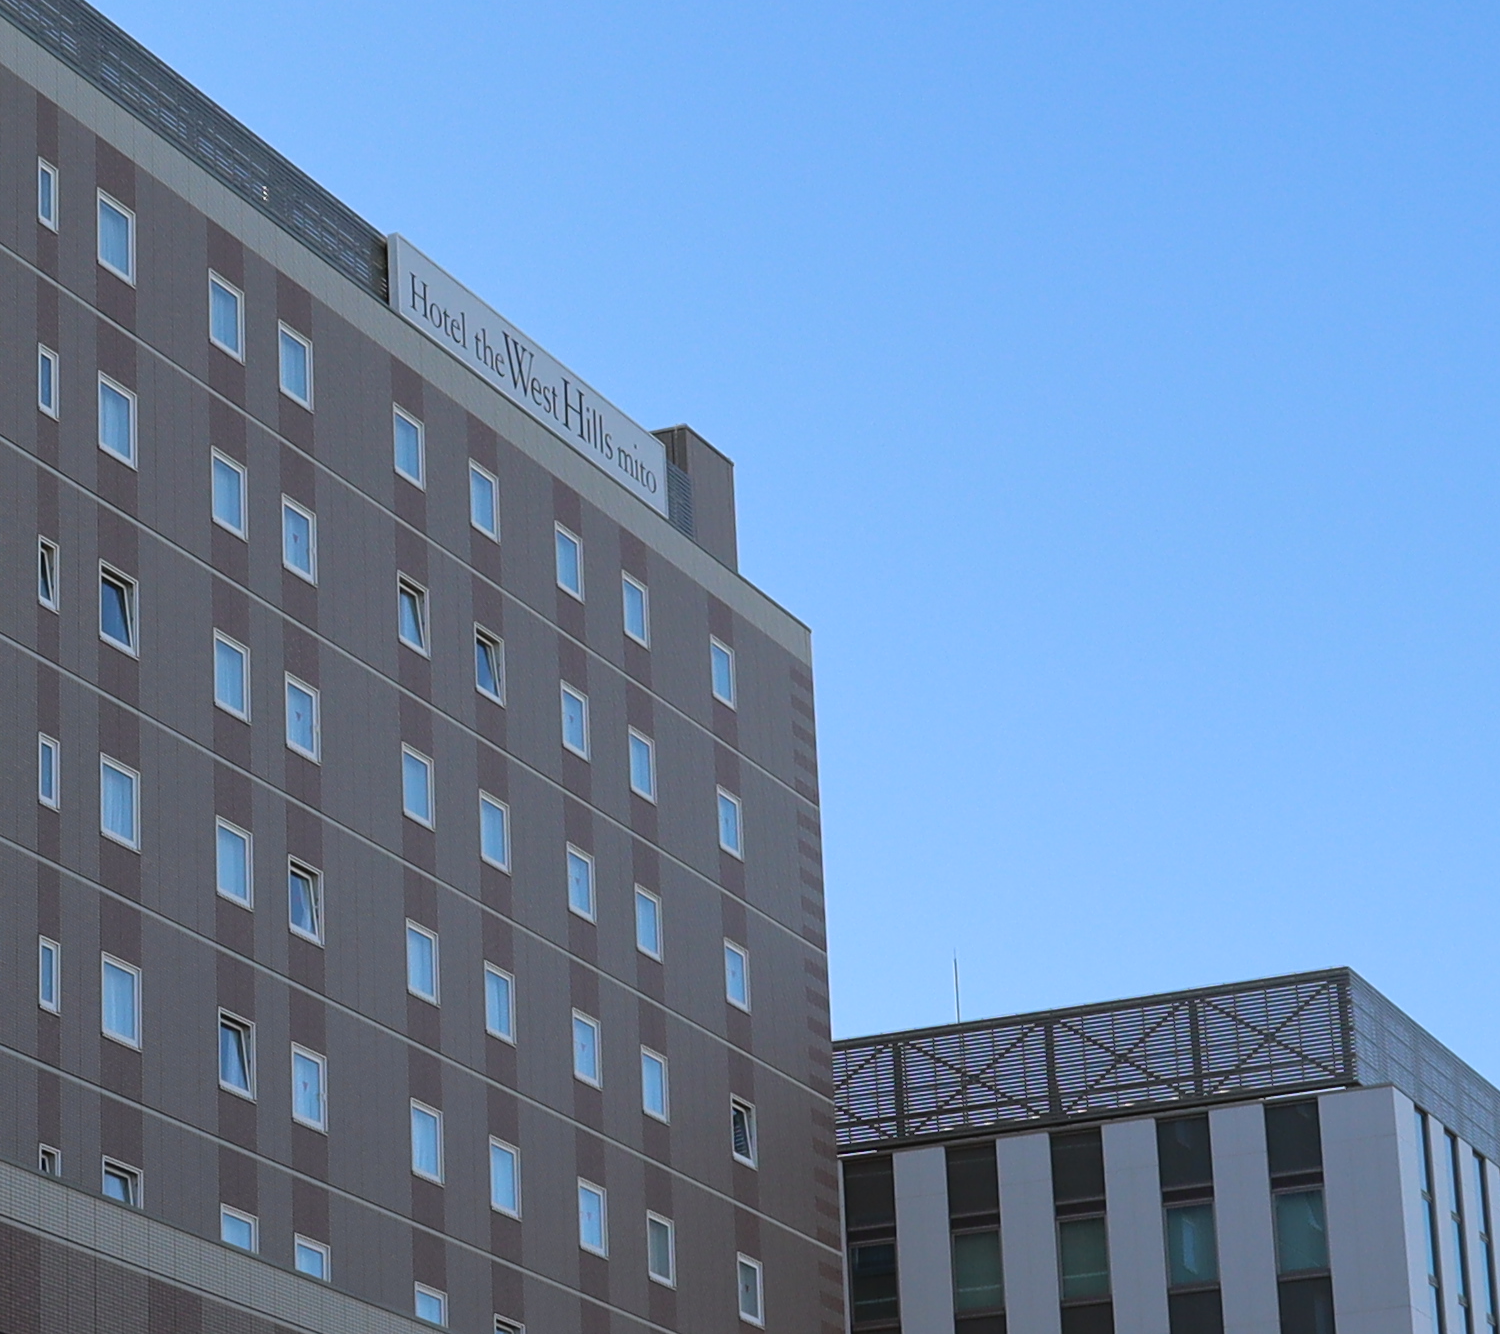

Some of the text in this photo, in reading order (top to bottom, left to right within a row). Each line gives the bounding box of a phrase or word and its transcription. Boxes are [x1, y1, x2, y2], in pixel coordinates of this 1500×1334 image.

[409, 272, 657, 494] Hotel the West Hills mito
